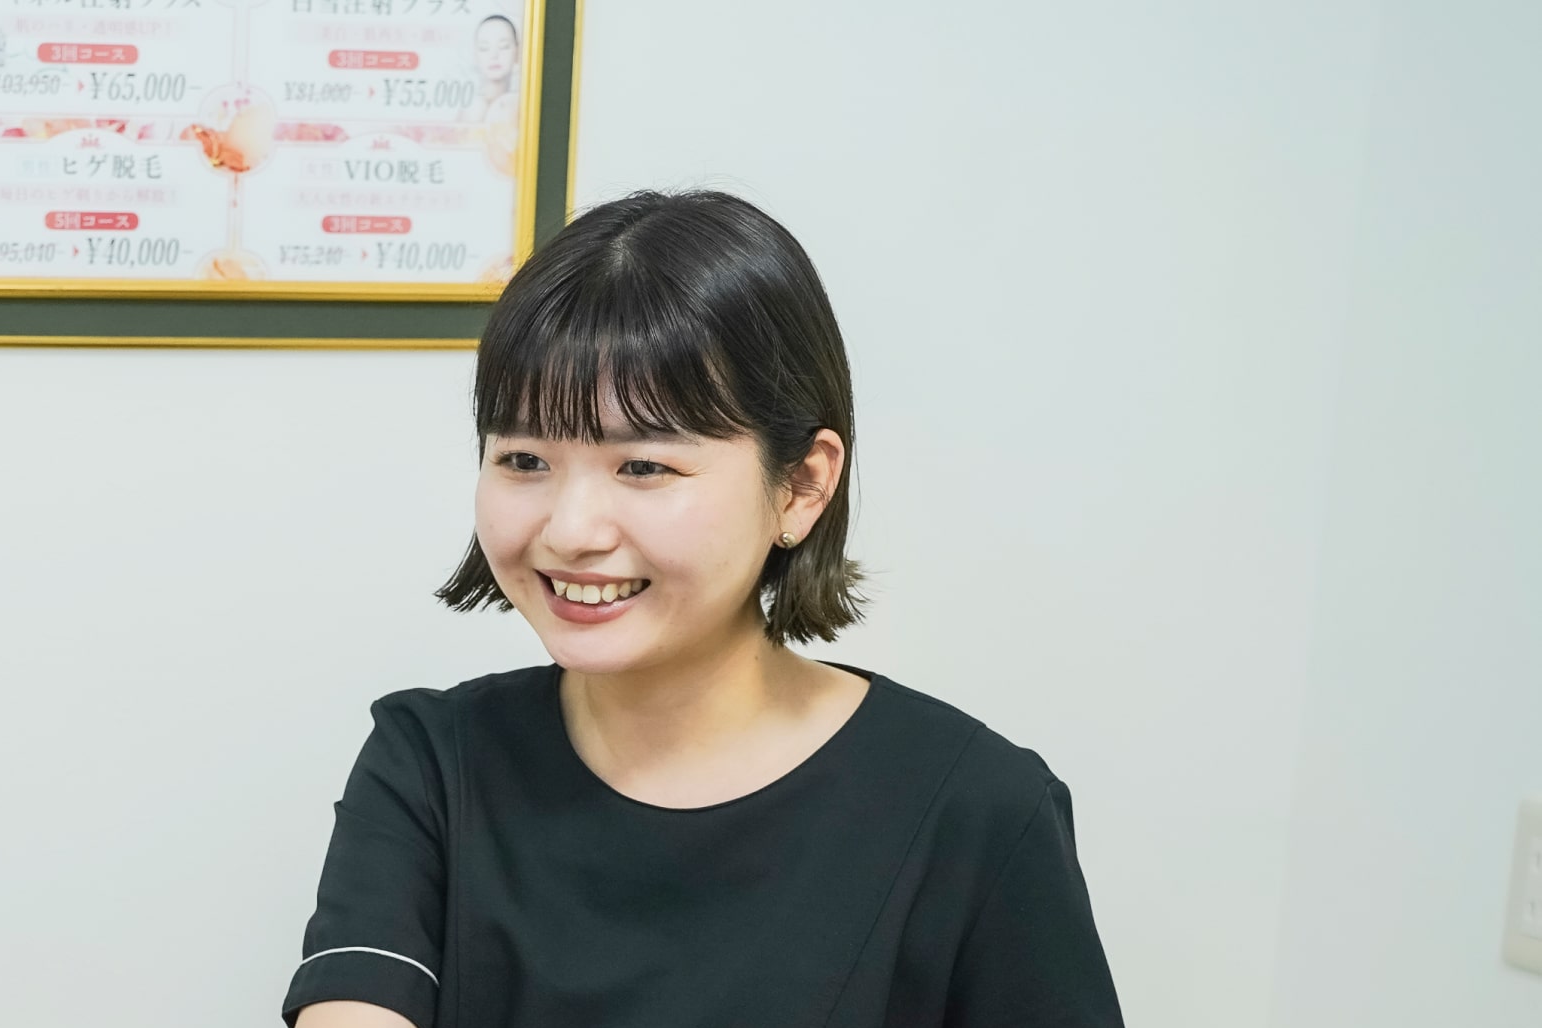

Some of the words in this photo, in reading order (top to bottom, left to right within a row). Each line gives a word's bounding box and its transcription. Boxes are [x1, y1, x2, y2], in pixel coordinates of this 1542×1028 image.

[51, 45, 126, 62] 3回コース
[62, 154, 163, 180] ヒゲ脱毛
[344, 159, 445, 184] VIO脱毛
